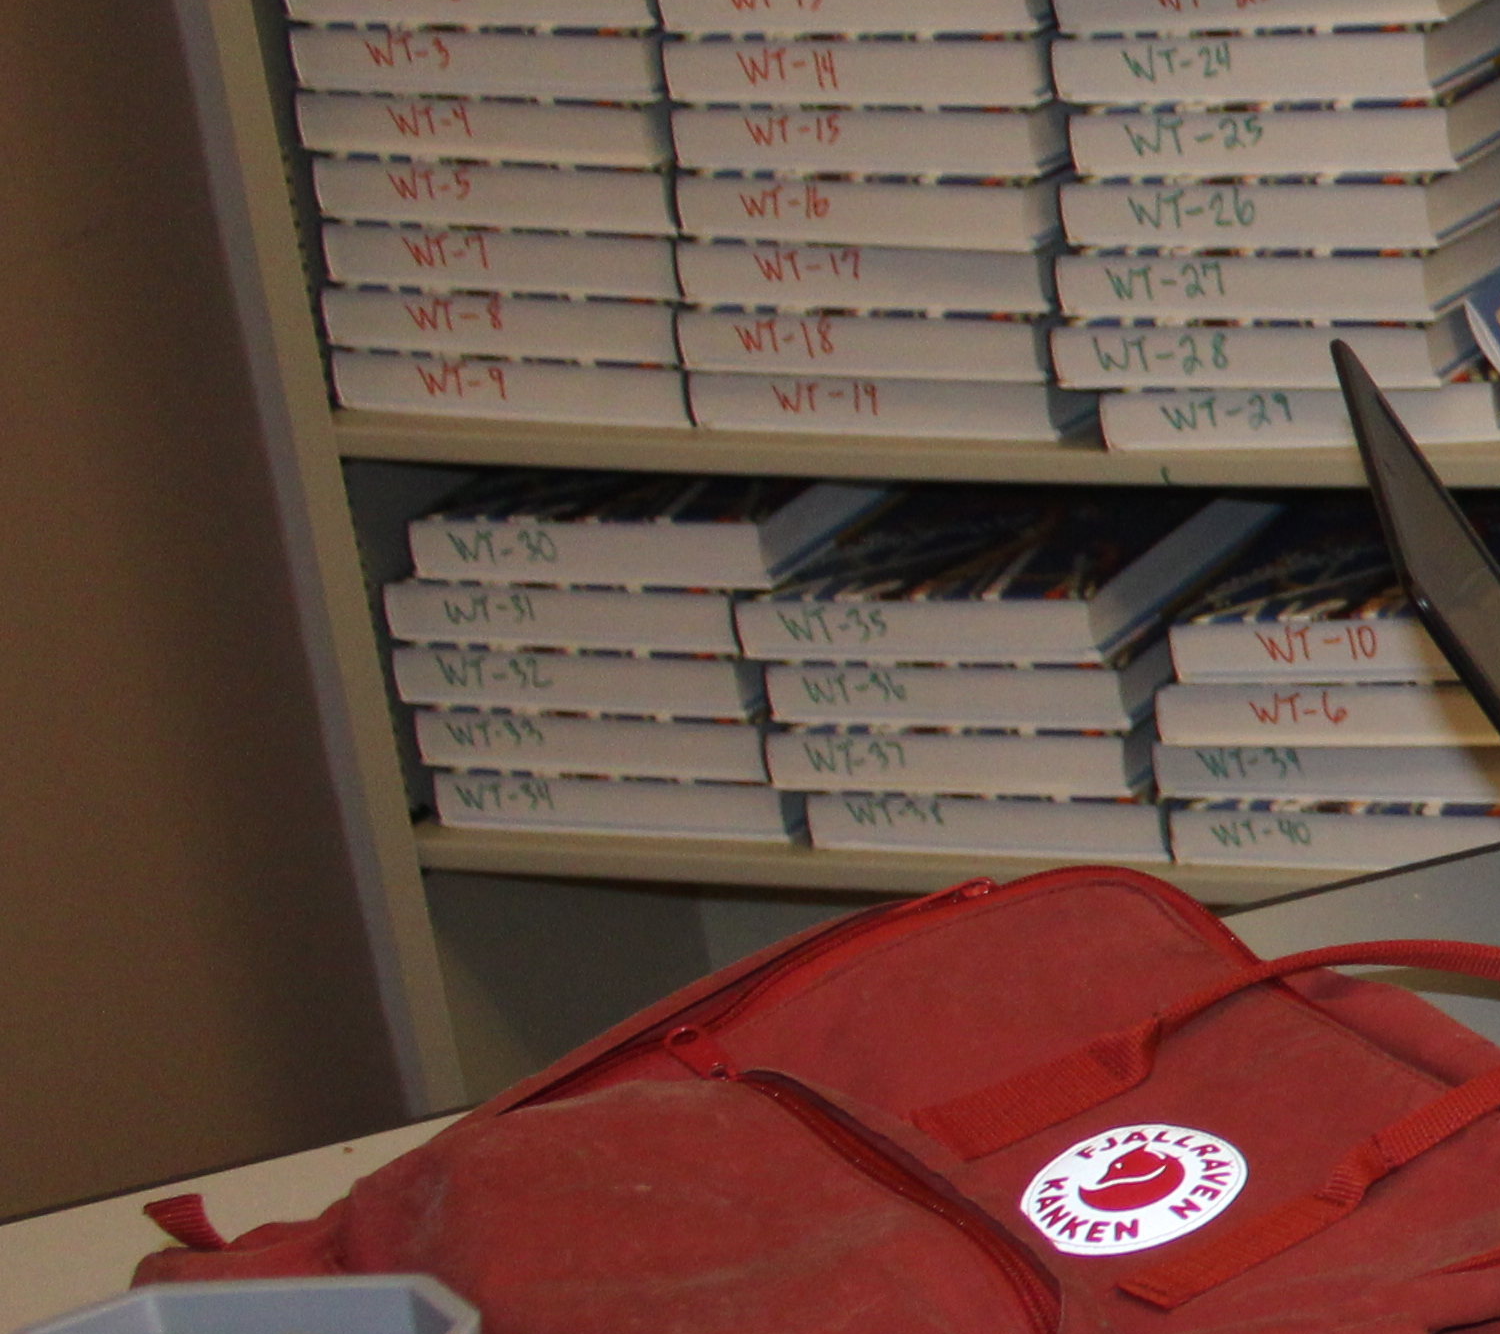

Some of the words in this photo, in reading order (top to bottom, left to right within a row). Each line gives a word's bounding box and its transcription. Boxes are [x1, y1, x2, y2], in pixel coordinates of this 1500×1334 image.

[362, 28, 457, 66] WT-3
[1119, 39, 1231, 82] WT-24
[733, 45, 844, 89] WT-14
[382, 101, 482, 137] WT-4
[740, 112, 848, 146] WT-15
[1119, 113, 1264, 157] WT-25
[383, 167, 479, 200] WT-5
[739, 183, 837, 219] WT-16
[1122, 179, 1262, 227] WT-26
[399, 229, 494, 268] WT-7
[753, 245, 862, 282] WT-17
[1100, 258, 1231, 300] WT-27
[400, 293, 502, 330] WT-8
[729, 317, 842, 358] WT-18
[1091, 330, 1228, 373] WT-28
[412, 360, 512, 399] WT-9
[771, 379, 878, 415] WT-19
[1155, 389, 1292, 431] WT-29
[445, 528, 553, 561] WT-30
[443, 592, 534, 625] WT-31
[773, 604, 887, 642] WT-35
[1249, 623, 1377, 664] WT-10
[432, 652, 559, 687] WT-32
[801, 670, 909, 704] WT-36
[1244, 688, 1354, 725] WT-6
[802, 736, 913, 772] WT-37
[453, 780, 552, 810] WT-34
[1210, 815, 1311, 847] WT-40
